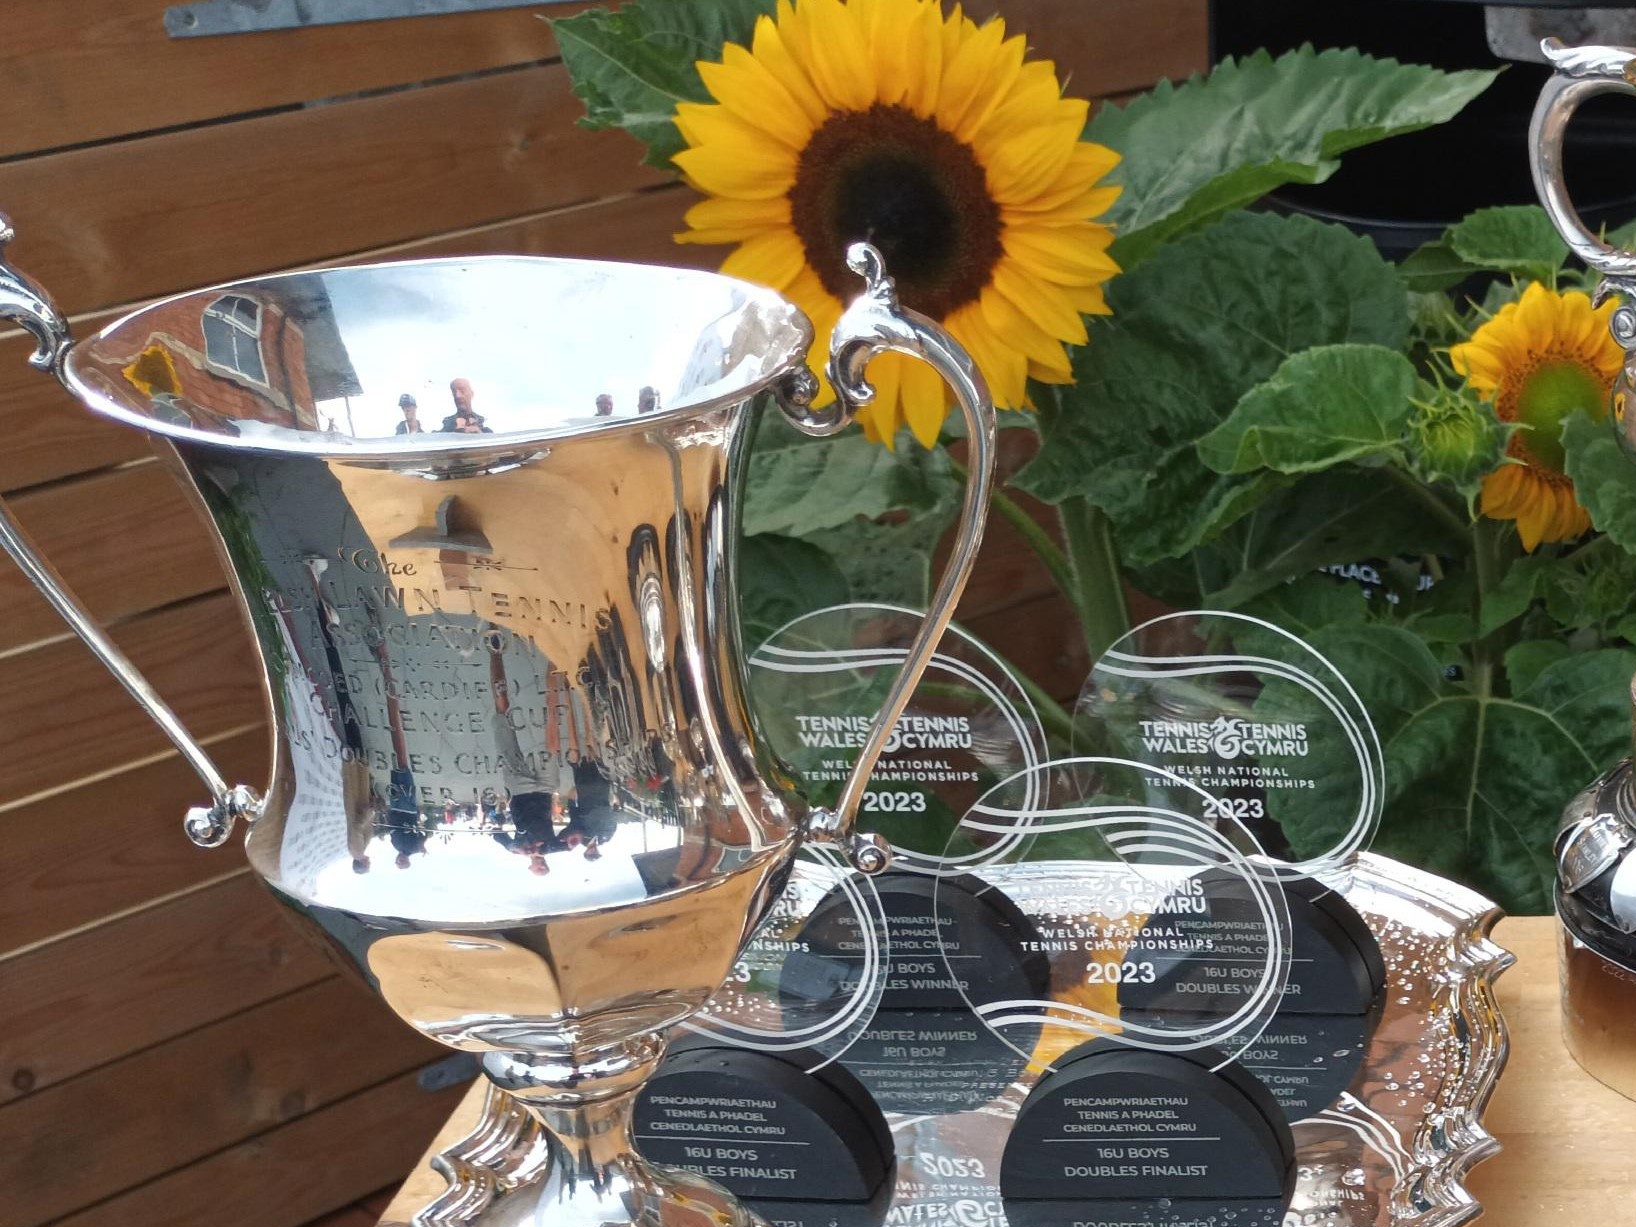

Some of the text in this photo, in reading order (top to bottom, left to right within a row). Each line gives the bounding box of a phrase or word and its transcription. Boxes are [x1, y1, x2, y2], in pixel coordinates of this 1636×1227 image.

[795, 716, 970, 732] TENNIS TENNIS
[1139, 721, 1307, 740] TENNIS TENNIS
[798, 732, 972, 749] WALES CYMRU
[1142, 738, 1309, 757] WALES CYMRU
[877, 760, 952, 770] NATIONAL
[1164, 765, 1288, 777] WELSH NATIONAL
[1201, 778, 1316, 789] CHAMPIONSHIPS
[863, 791, 926, 812] 2023
[1201, 798, 1265, 819] 2023
[1126, 896, 1207, 914] CYMRU
[1042, 927, 1184, 939] WELSH NATIONAL
[1020, 938, 1214, 952] TENNIS CHAMPIONSHIPS
[898, 964, 936, 974] BOYS
[1086, 962, 1156, 984] 2023
[1203, 967, 1227, 978] 16U
[1176, 982, 1241, 994] DOUBLES
[650, 1096, 777, 1109] PENCAMPWRIAETHAU
[1063, 1097, 1189, 1107] PENCAMPWRIAETHAU
[664, 1108, 767, 1122] TENNIS A PHADEL
[1077, 1109, 1179, 1120] TENNIS A PHADEL
[650, 1121, 786, 1135] CENEDLAETHOL CYMRU
[1063, 1123, 1197, 1133] CENEDLAETHOL CYMRU
[684, 1146, 759, 1161] 16U BOYS
[1097, 1147, 1170, 1159] 16U BOYS
[729, 1166, 797, 1179] FINALIST
[1064, 1165, 1209, 1178] DOUBLES FINALIST
